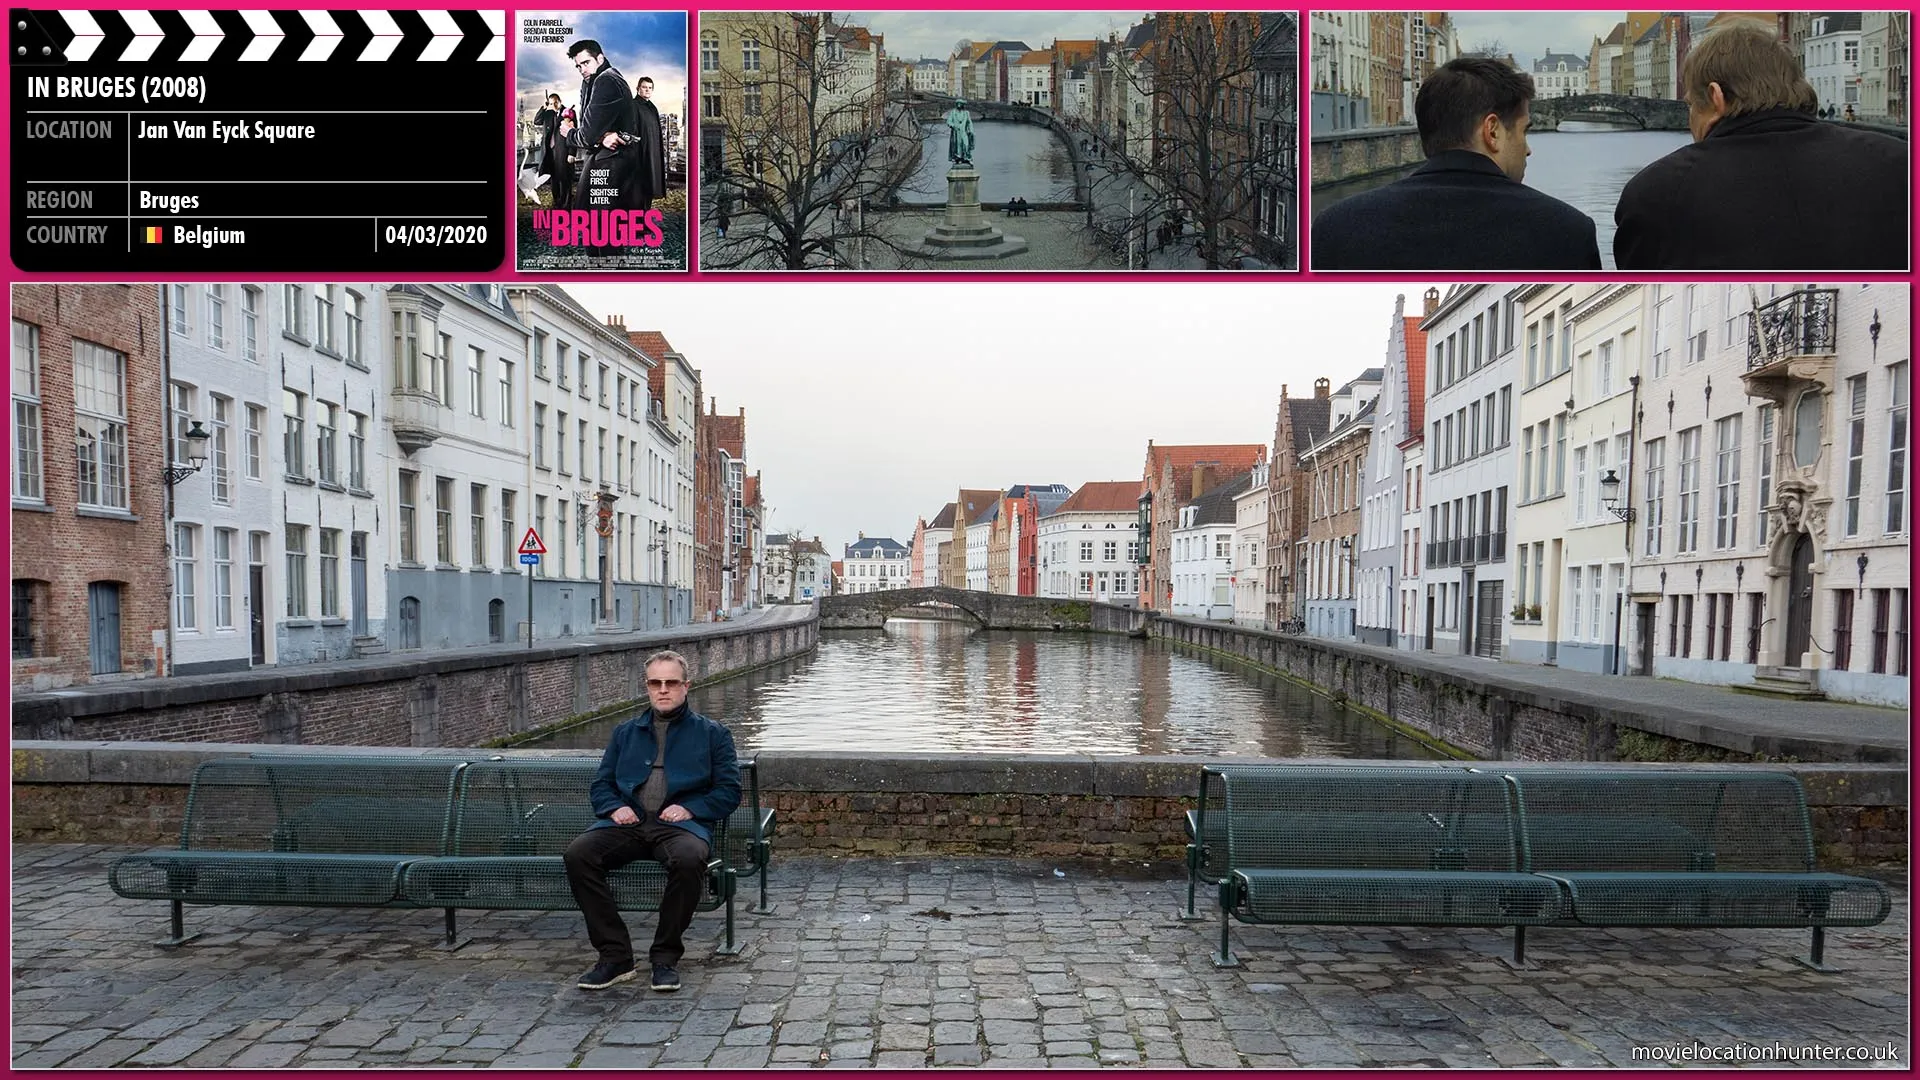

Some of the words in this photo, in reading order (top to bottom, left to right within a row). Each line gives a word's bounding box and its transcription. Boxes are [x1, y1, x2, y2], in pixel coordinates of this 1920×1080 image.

[523, 19, 538, 27] COLIN
[539, 19, 563, 27] FARRELL
[523, 27, 548, 35] BRENDAN
[548, 27, 573, 35] GLEESON
[523, 35, 541, 43] RALPH
[541, 35, 564, 43] FIENNES
[589, 169, 610, 177] SHOOT
[589, 177, 609, 186] FIRST.
[589, 188, 619, 197] SIGHTSEE
[589, 197, 610, 205] LATER.
[533, 209, 551, 229] IN
[551, 209, 664, 247] BRUGES
